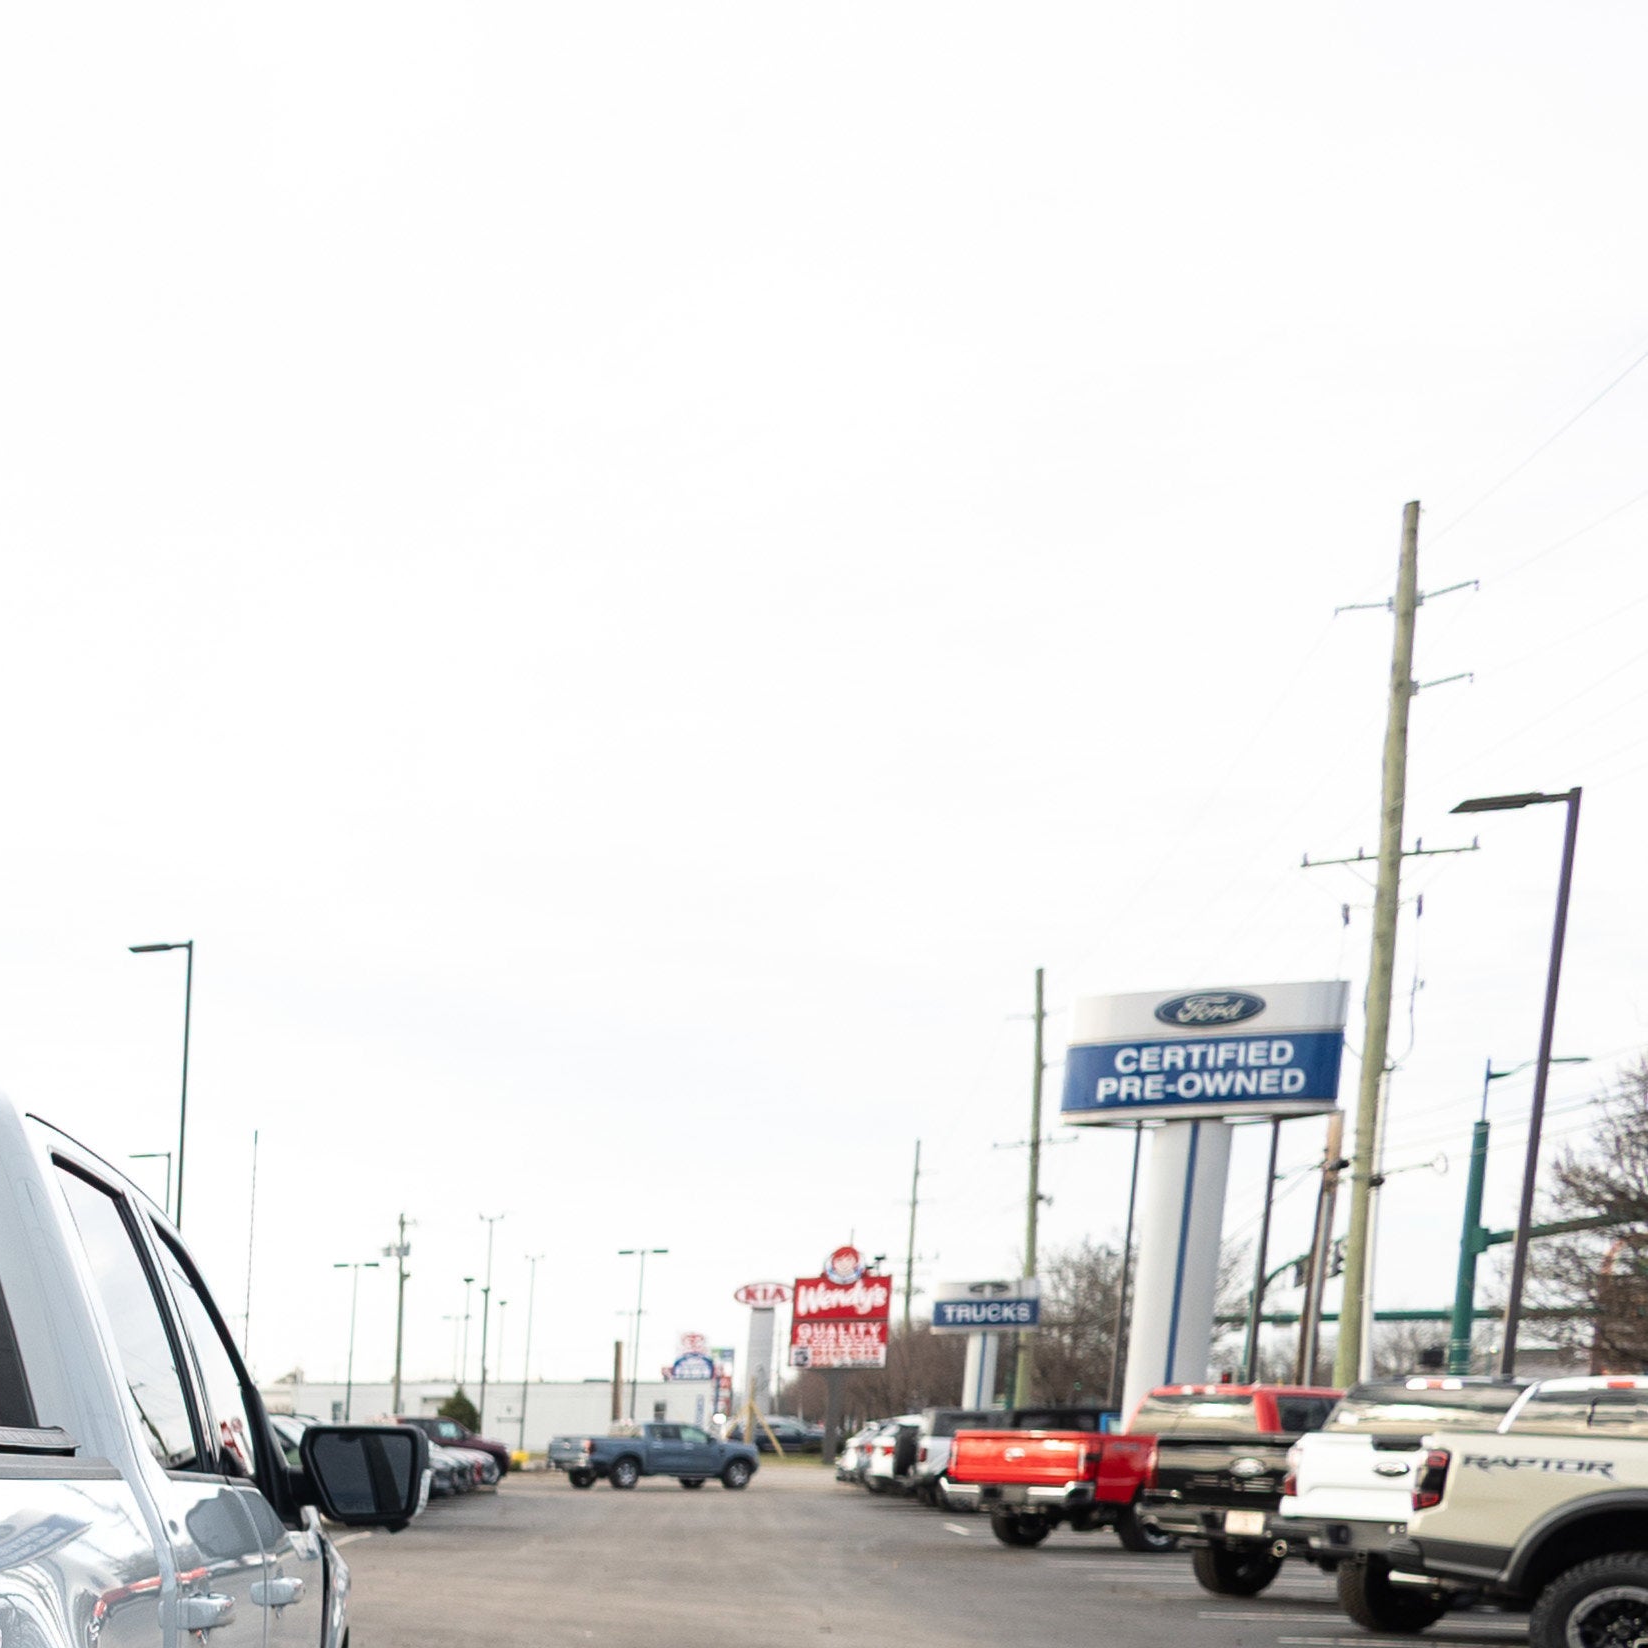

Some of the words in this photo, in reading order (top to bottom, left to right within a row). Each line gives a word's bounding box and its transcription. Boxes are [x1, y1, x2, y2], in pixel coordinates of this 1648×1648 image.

[1176, 994, 1245, 1023] Ford
[1114, 1039, 1295, 1074] CERTIFIED
[1096, 1068, 1305, 1102] PRE-OWNED
[745, 1287, 786, 1301] KIA
[797, 1281, 888, 1317] Wendy's
[942, 1303, 1031, 1323] TRUCKS
[797, 1322, 882, 1341] QUALITY
[1463, 1454, 1617, 1480] RAPTOR
